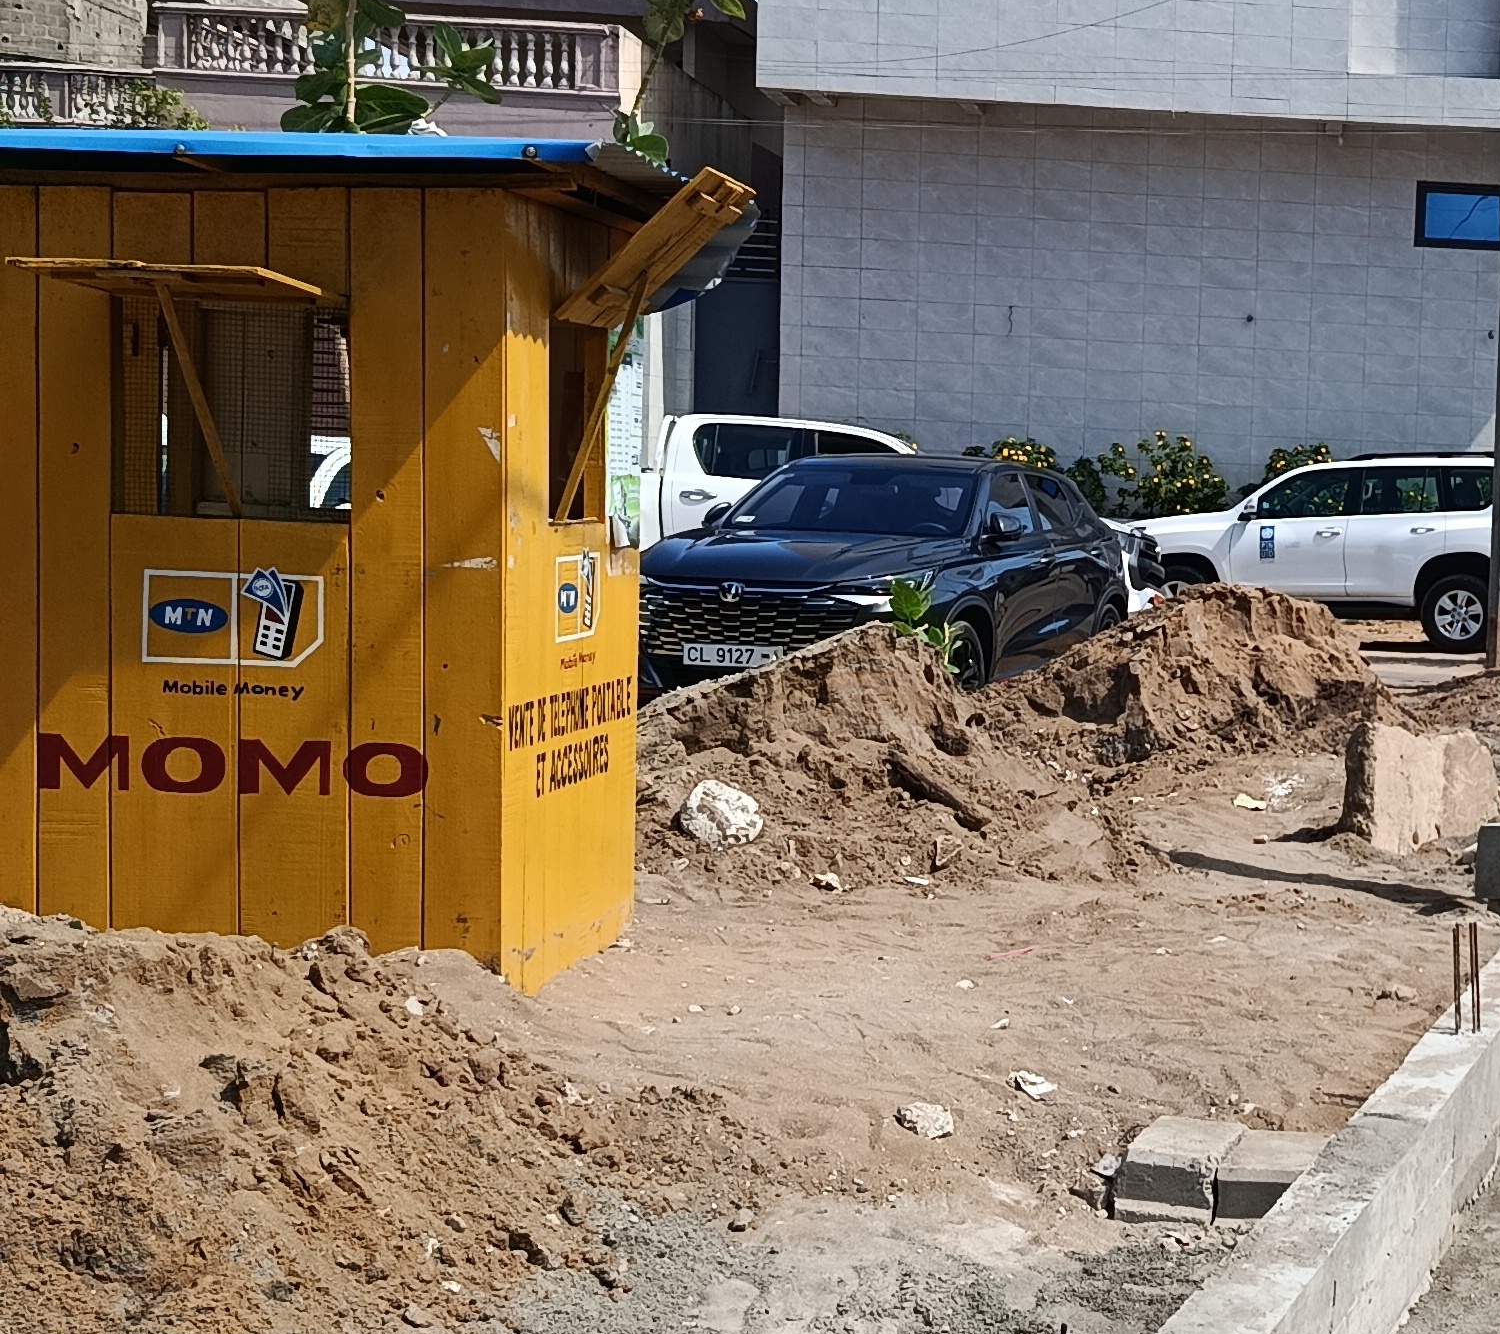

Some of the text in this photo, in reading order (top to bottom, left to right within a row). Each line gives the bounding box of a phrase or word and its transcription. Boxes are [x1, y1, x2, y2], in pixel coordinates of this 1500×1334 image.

[164, 605, 214, 627] MTN
[687, 646, 755, 665] CL 9127
[162, 679, 305, 702] Mobile Money
[508, 674, 633, 752] VENTE DE TELEPHONE PORTABLE
[36, 732, 430, 799] MOMO
[536, 733, 609, 799] ET ACCESSOIRES
